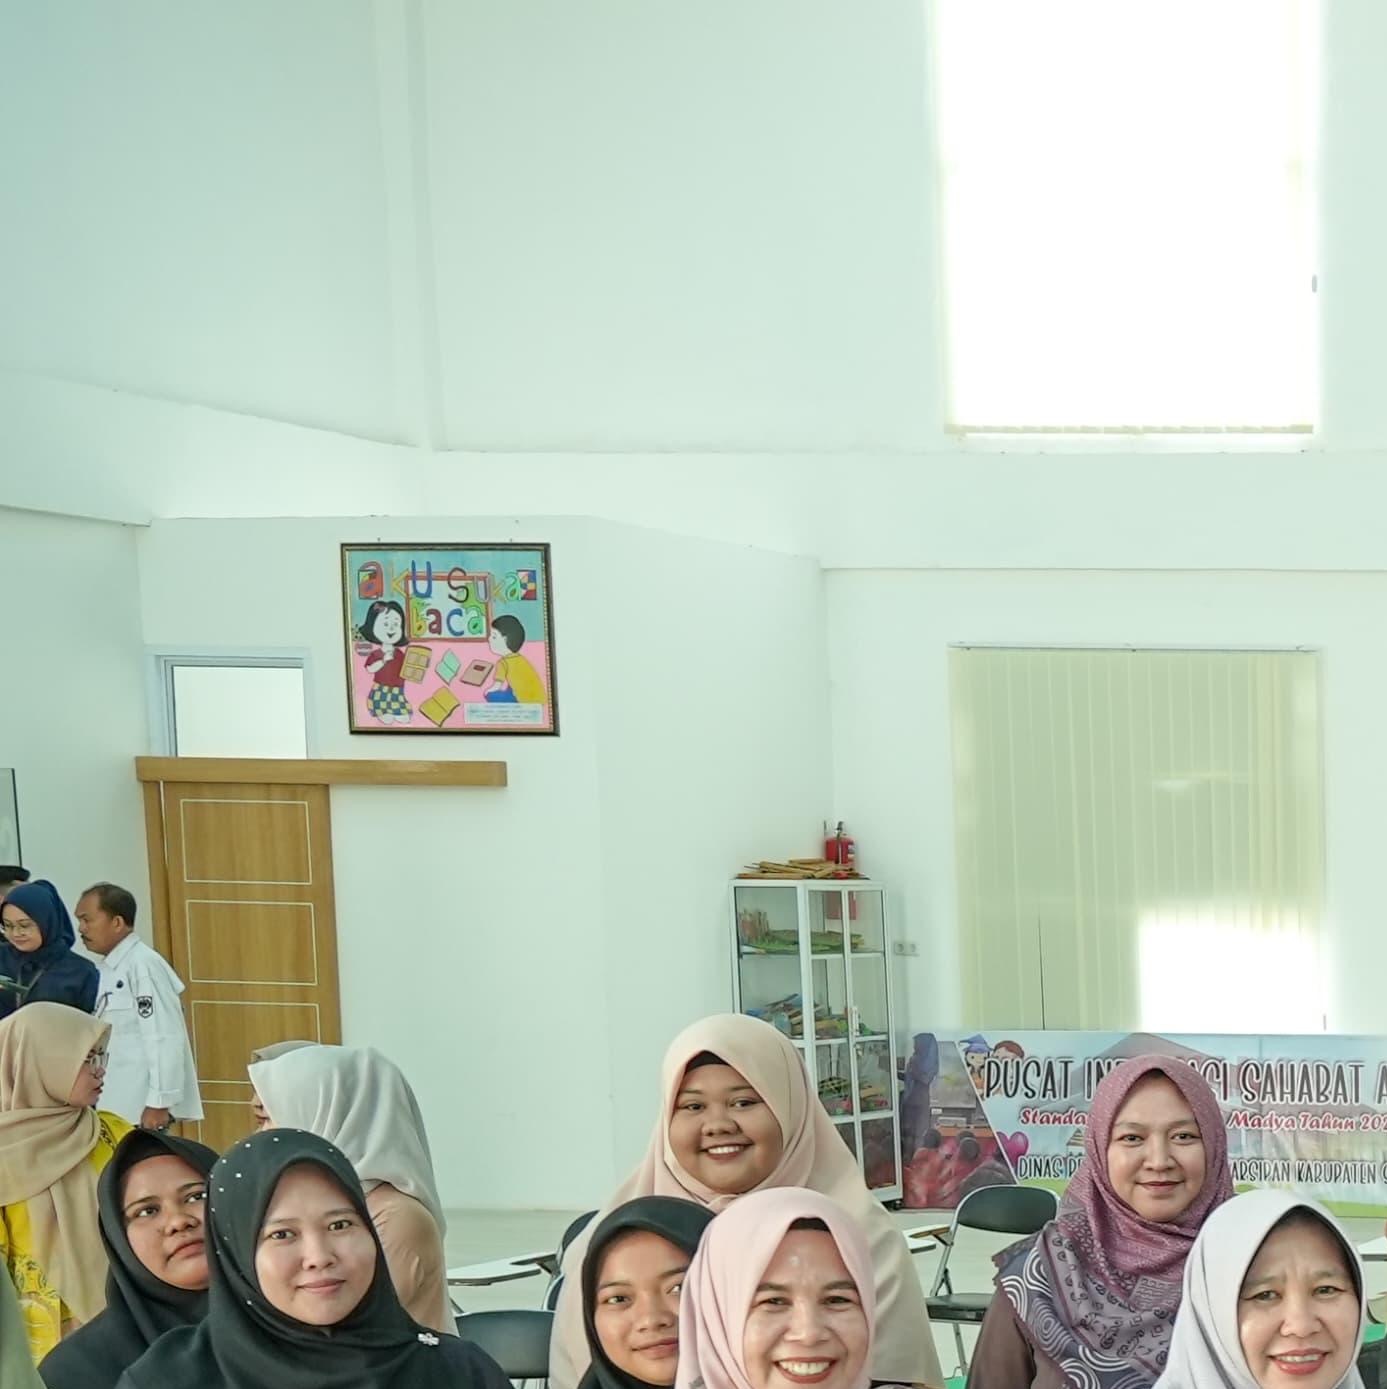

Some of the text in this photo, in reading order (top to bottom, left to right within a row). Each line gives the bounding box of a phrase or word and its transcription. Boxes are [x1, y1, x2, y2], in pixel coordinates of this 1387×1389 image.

[411, 605, 484, 637] baca
[985, 1058, 1075, 1100] PUSAT
[1240, 1060, 1367, 1105] SAHABAT
[1020, 1109, 1088, 1126] Standa
[1228, 1110, 1297, 1131] Madya
[1300, 1112, 1356, 1131] Tahun
[1018, 1157, 1062, 1179] DINAS
[1231, 1159, 1291, 1183] ARSIPAN
[1296, 1159, 1378, 1186] KABUPATEN
